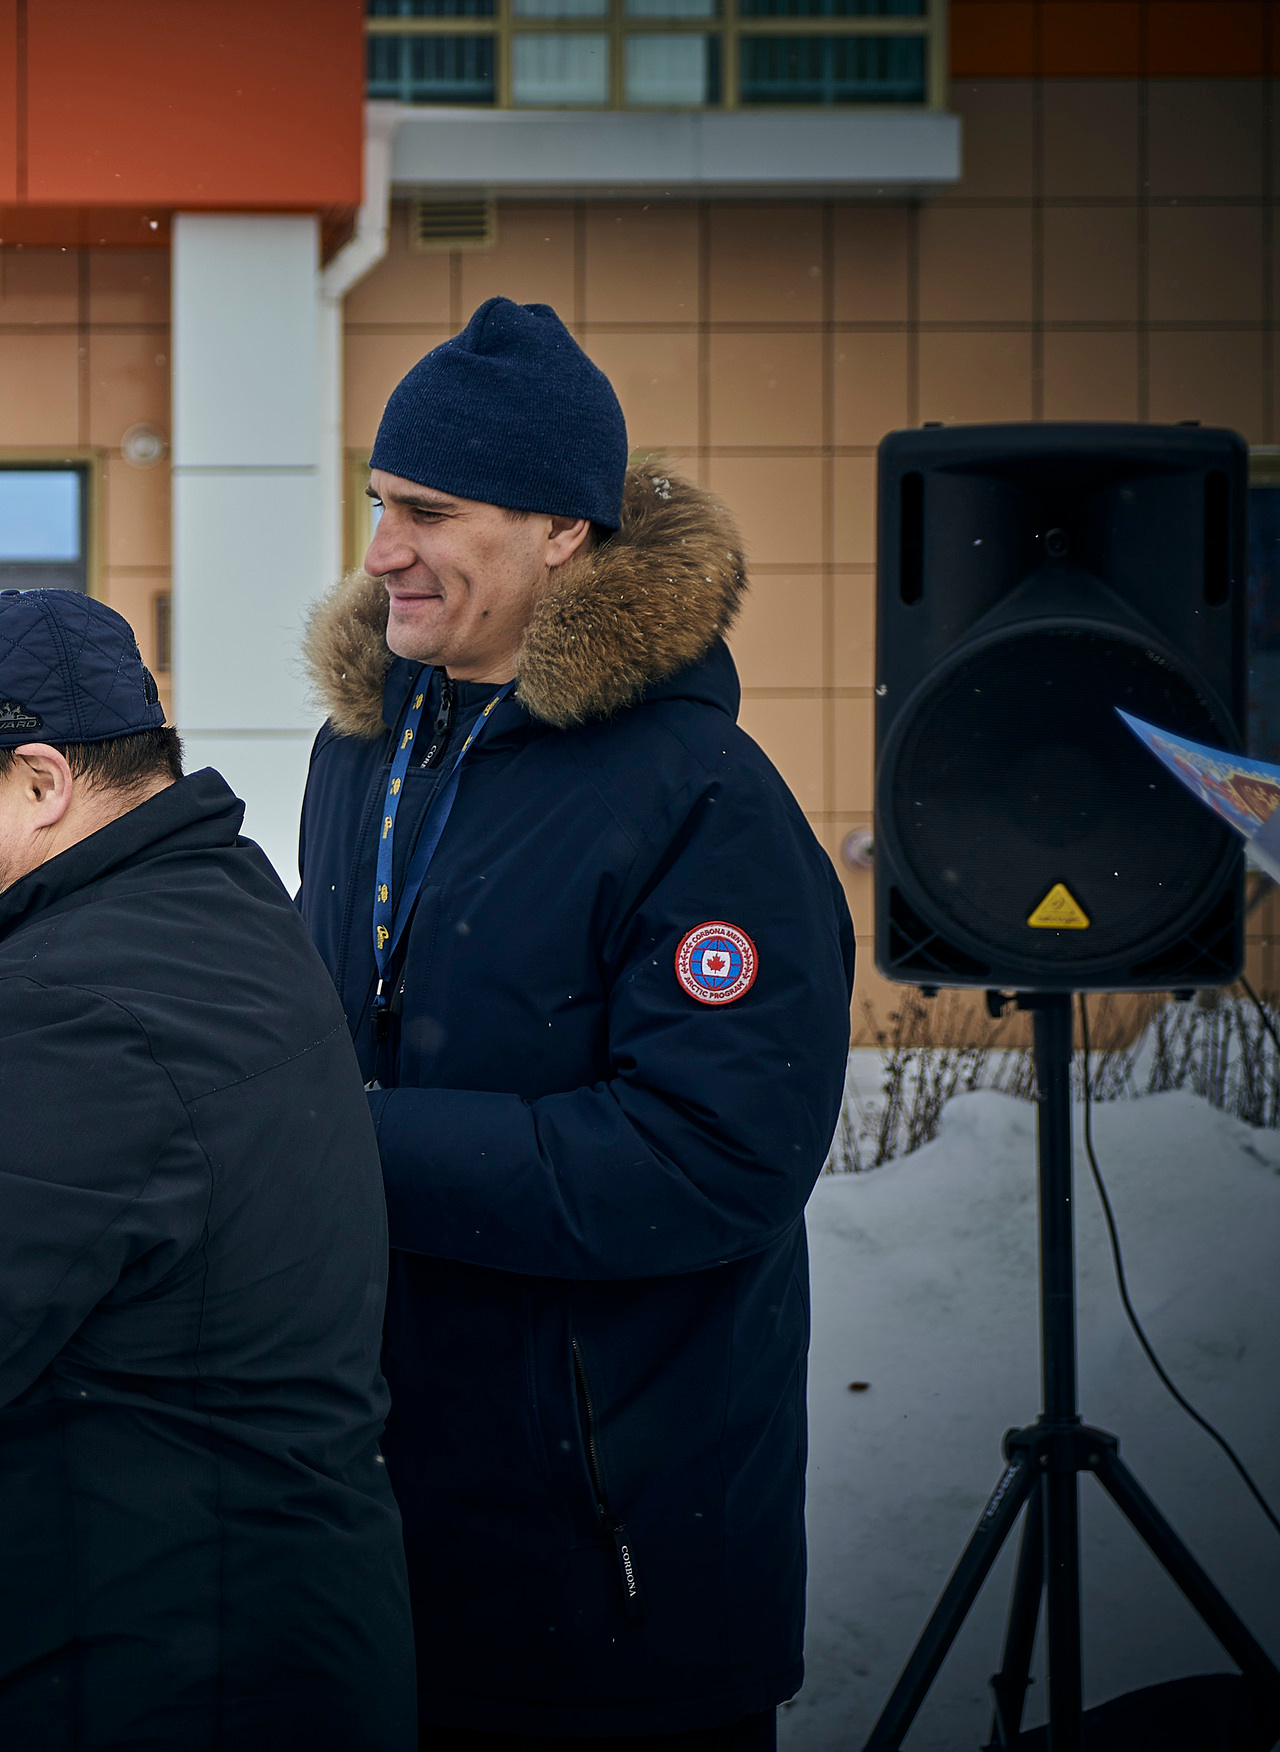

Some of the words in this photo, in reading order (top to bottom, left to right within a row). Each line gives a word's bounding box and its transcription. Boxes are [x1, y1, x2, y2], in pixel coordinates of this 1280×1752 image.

[692, 928, 725, 944] CORBONA
[684, 977, 709, 998] ARCTIC
[709, 981, 745, 999] PROGRAM
[621, 1545, 637, 1597] CORBONA
